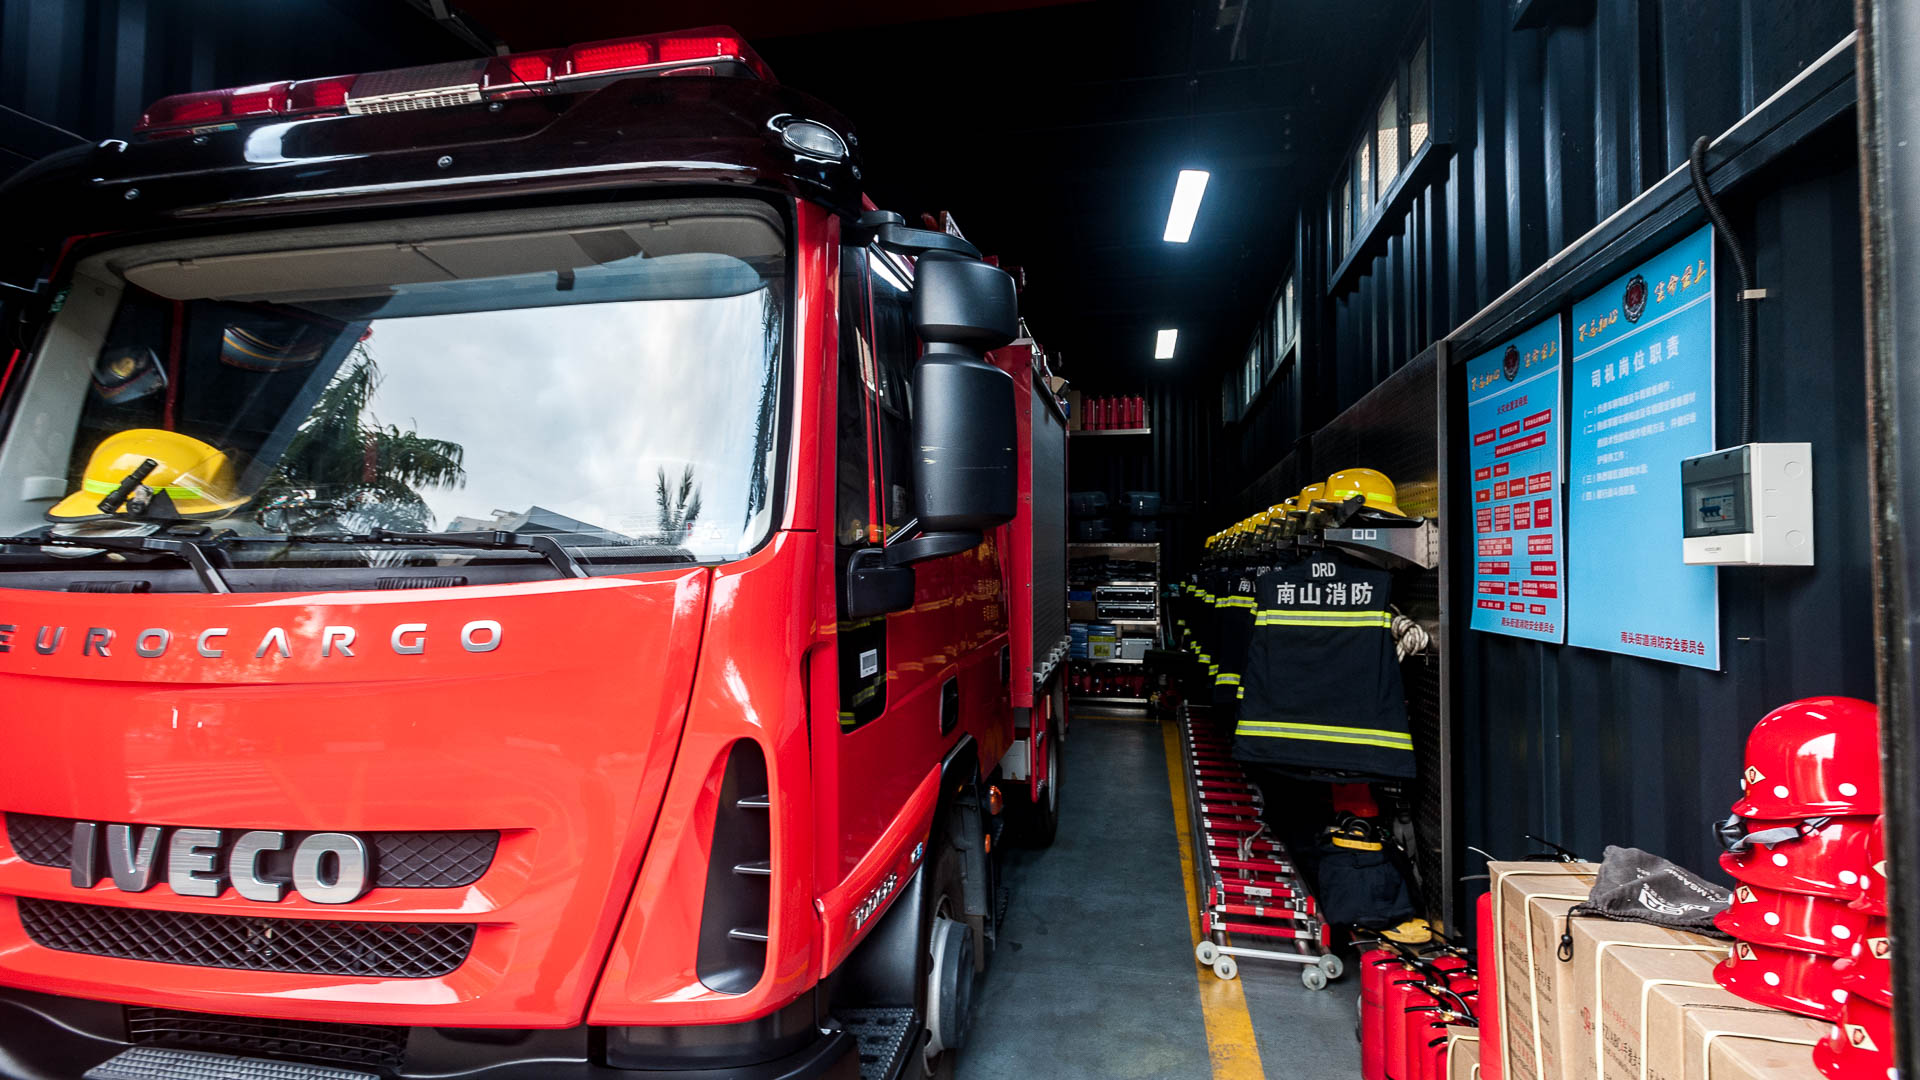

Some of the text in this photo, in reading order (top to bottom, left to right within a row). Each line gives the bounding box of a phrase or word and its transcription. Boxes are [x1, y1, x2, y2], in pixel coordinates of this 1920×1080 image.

[1590, 334, 1681, 388] 司机岗位职责
[1312, 562, 1336, 578] DRD
[1277, 581, 1374, 606] 南山消防
[0, 619, 503, 659] EUROCARGO
[1620, 630, 1706, 656] 南头街道消防安全委员会
[70, 821, 371, 905] IVECO
